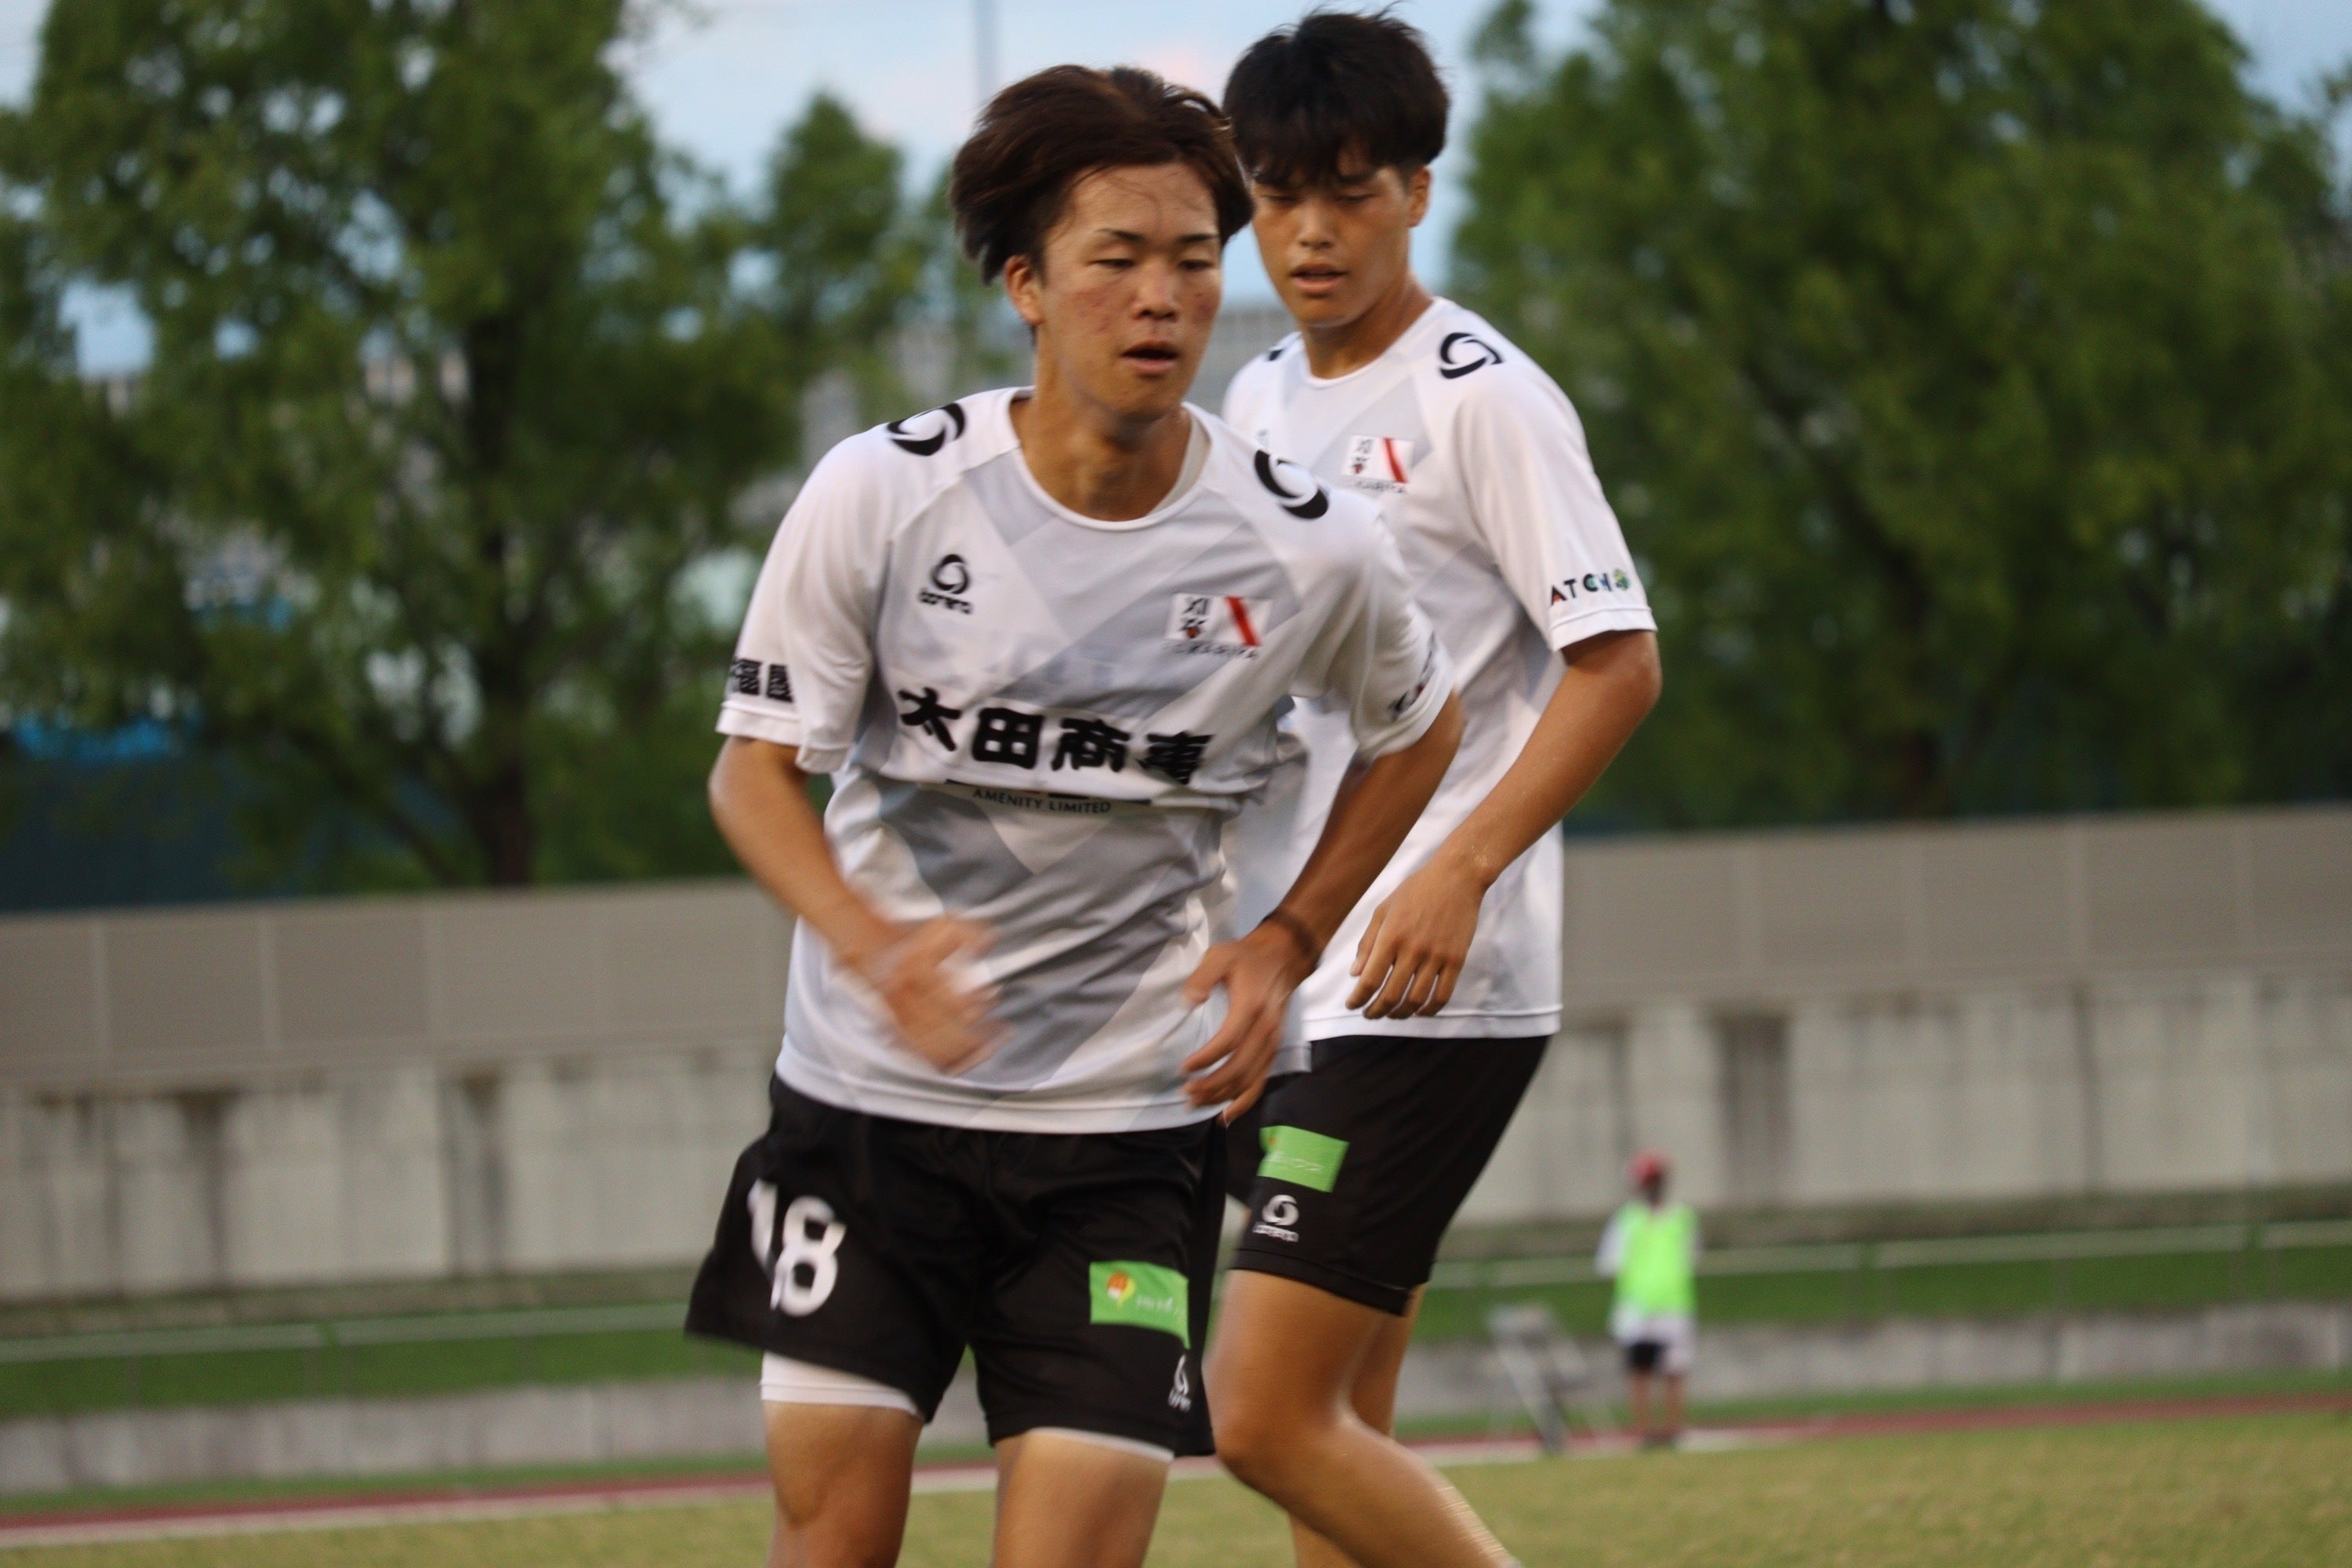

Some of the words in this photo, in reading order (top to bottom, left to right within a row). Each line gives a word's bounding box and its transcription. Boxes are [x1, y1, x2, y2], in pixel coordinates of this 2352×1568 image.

[973, 789, 1043, 810] AMENITY
[1047, 798, 1112, 814] LIMITED
[746, 1178, 847, 1317] 18
